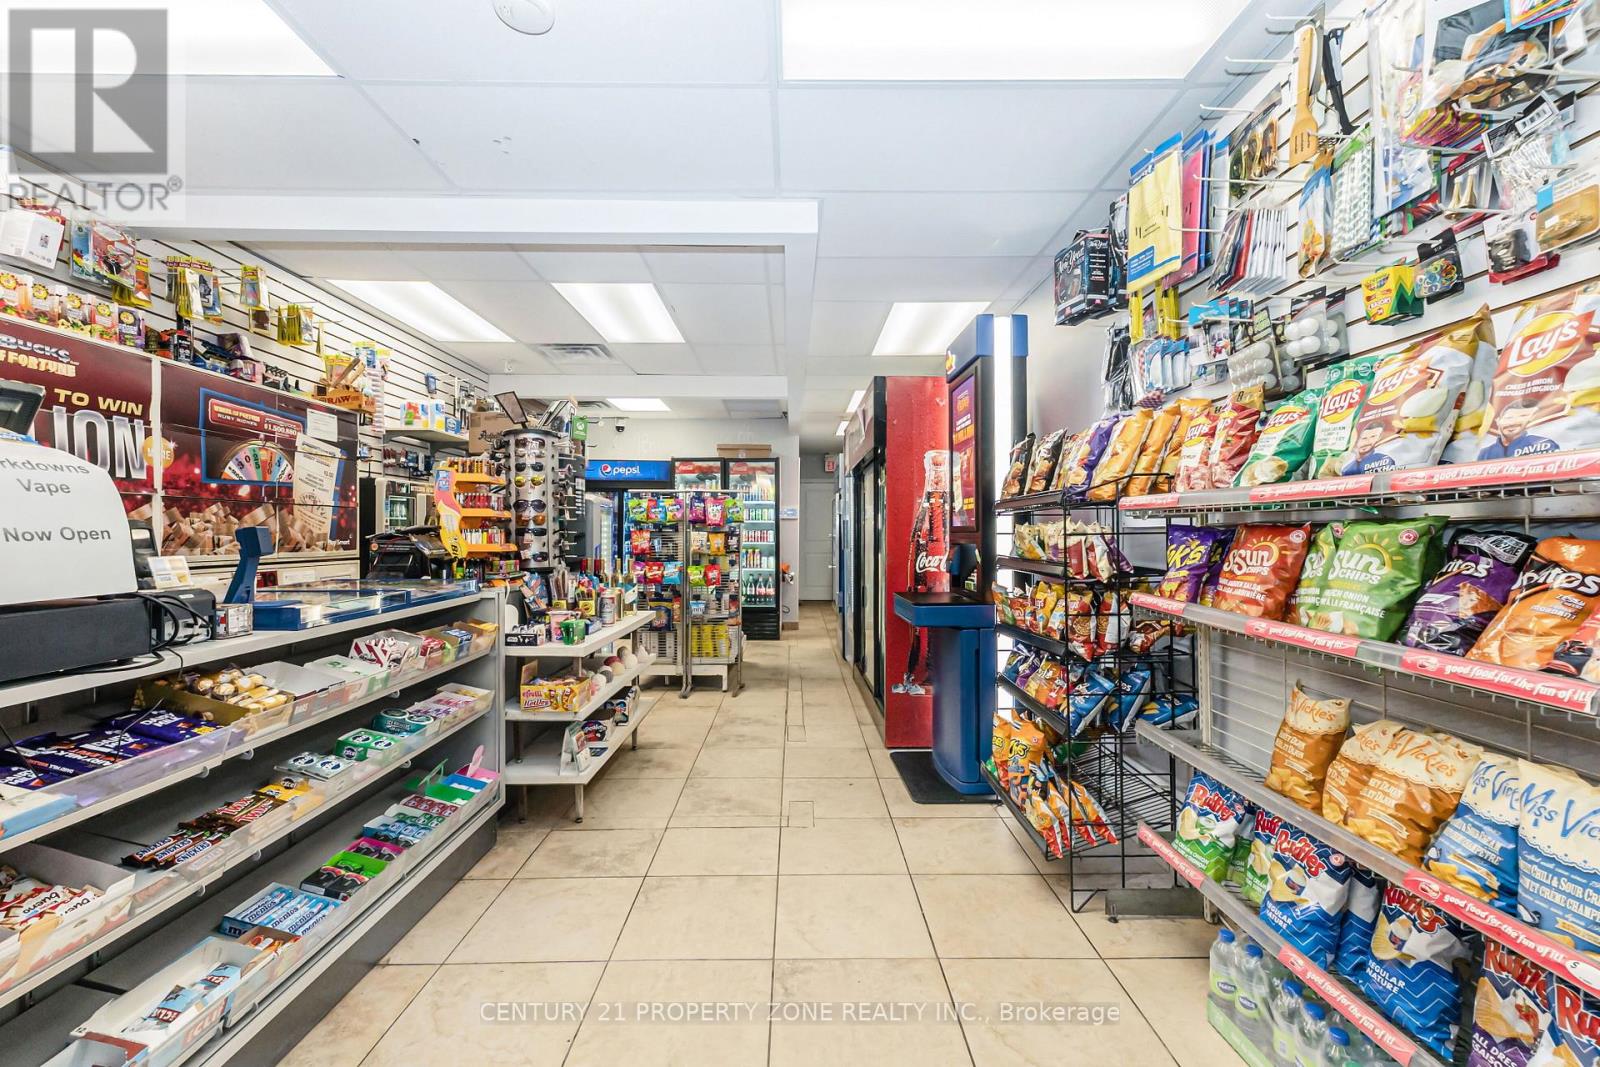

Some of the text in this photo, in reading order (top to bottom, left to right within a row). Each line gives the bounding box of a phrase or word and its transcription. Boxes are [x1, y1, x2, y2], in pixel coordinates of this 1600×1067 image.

[7, 351, 77, 378] FORTUNE
[54, 388, 143, 416] TO WIN
[1514, 442, 1551, 457] DAVID
[0, 457, 90, 474] rkdowns
[613, 466, 640, 476] pepsi
[1364, 458, 1389, 470] DAVID
[17, 478, 71, 496] Vape
[4, 526, 111, 543] Now Open
[1338, 569, 1381, 585] CHIPS
[1445, 663, 1470, 675] good
[1471, 667, 1495, 679] food
[1494, 671, 1514, 683] for
[1515, 675, 1533, 691] the
[1532, 682, 1556, 696] fun
[1557, 688, 1574, 702] of
[1520, 783, 1558, 827] Miss
[1254, 810, 1282, 836] Ruff
[135, 836, 173, 859] SNICKERS
[155, 838, 192, 861] SNICKERS
[175, 840, 212, 864] SNICKERS
[1273, 829, 1328, 878] Ruffles
[1560, 877, 1584, 899] SOUR
[1584, 887, 1600, 907] CRE
[247, 900, 277, 921] mentos
[271, 906, 299, 928] mentos
[287, 910, 315, 932] mentos
[1443, 894, 1466, 909] good
[1465, 902, 1487, 919] food
[1486, 910, 1501, 927] for
[1502, 921, 1519, 939] the
[1517, 932, 1536, 950] fun
[1536, 943, 1550, 958] of
[1366, 967, 1400, 994] NATURE
[1472, 1032, 1489, 1049] ALL
